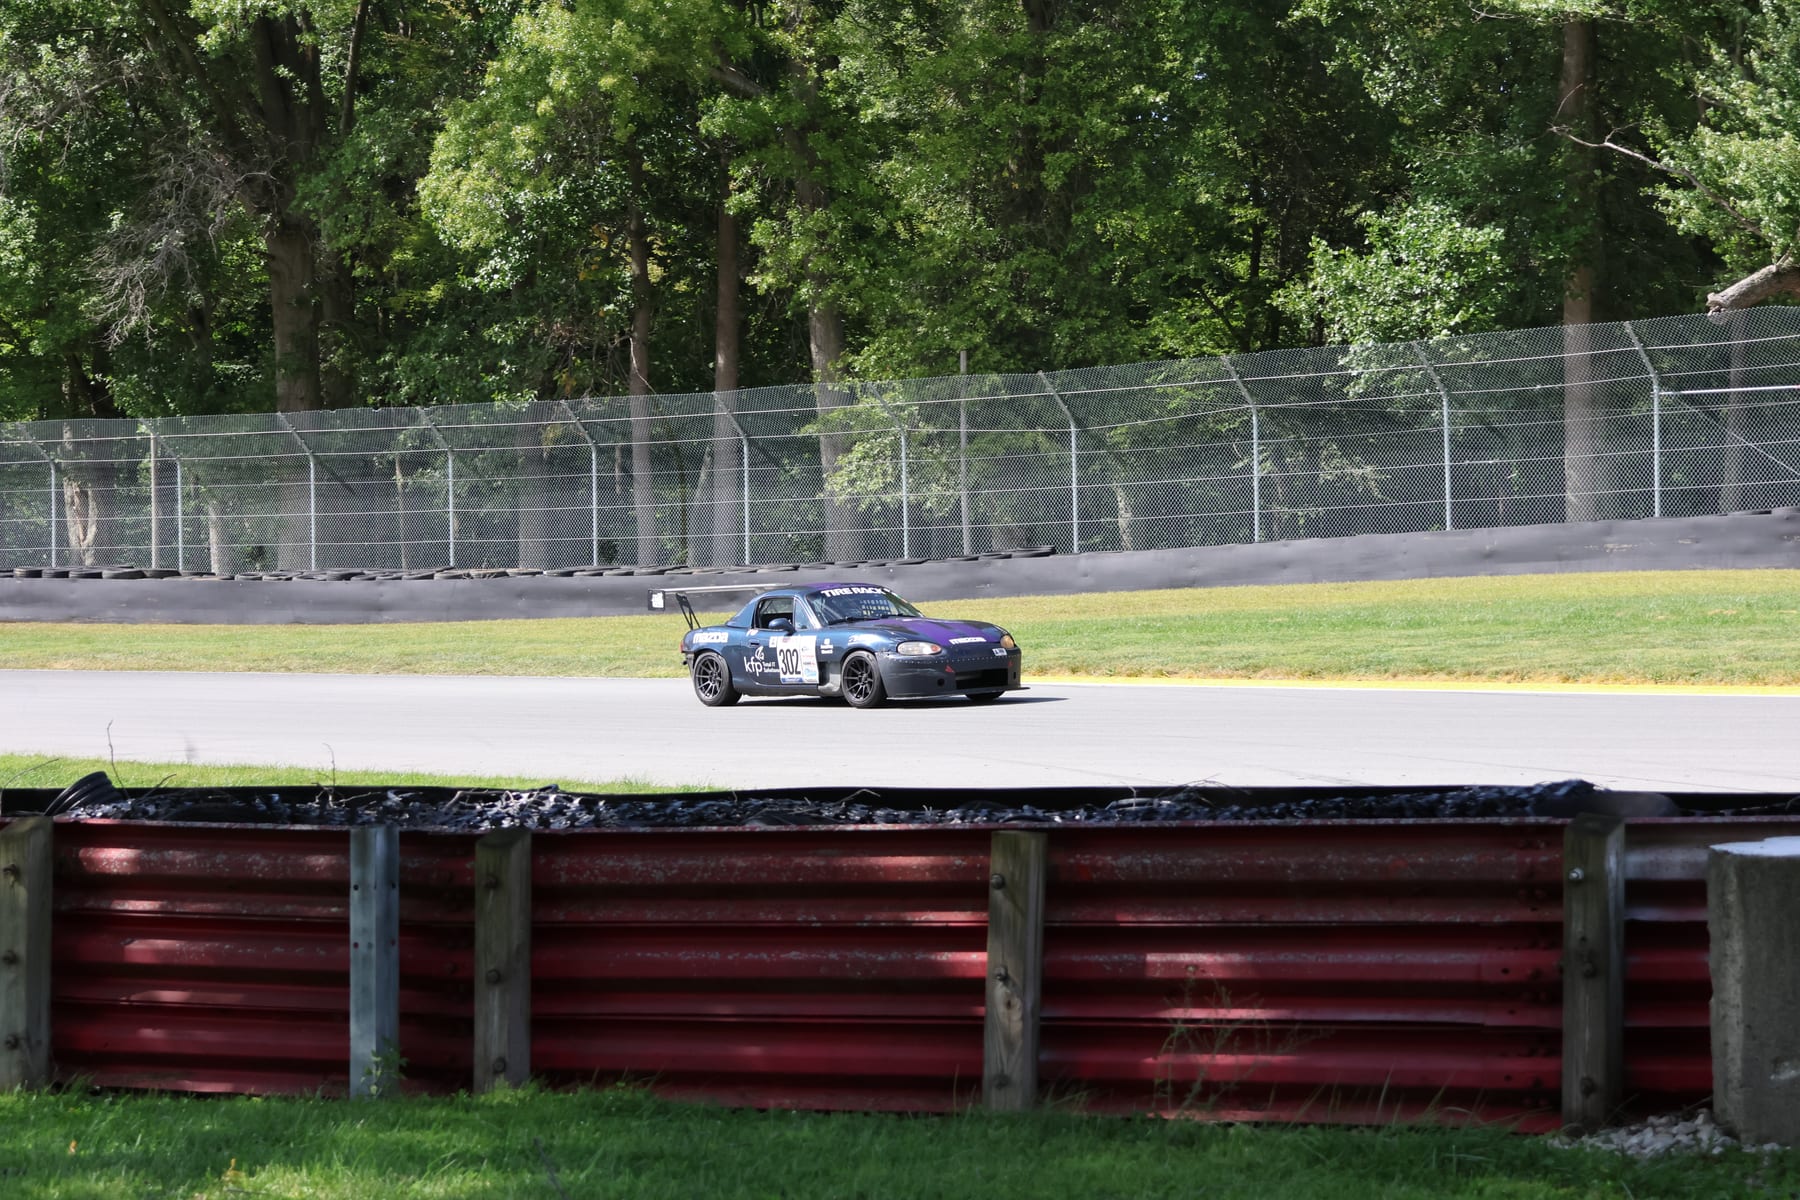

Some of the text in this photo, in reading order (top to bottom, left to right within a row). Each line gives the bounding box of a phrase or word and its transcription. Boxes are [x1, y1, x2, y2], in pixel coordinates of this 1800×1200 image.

[821, 587, 886, 597] TIRE RACK
[744, 656, 763, 677] kfp
[779, 649, 801, 675] 302
